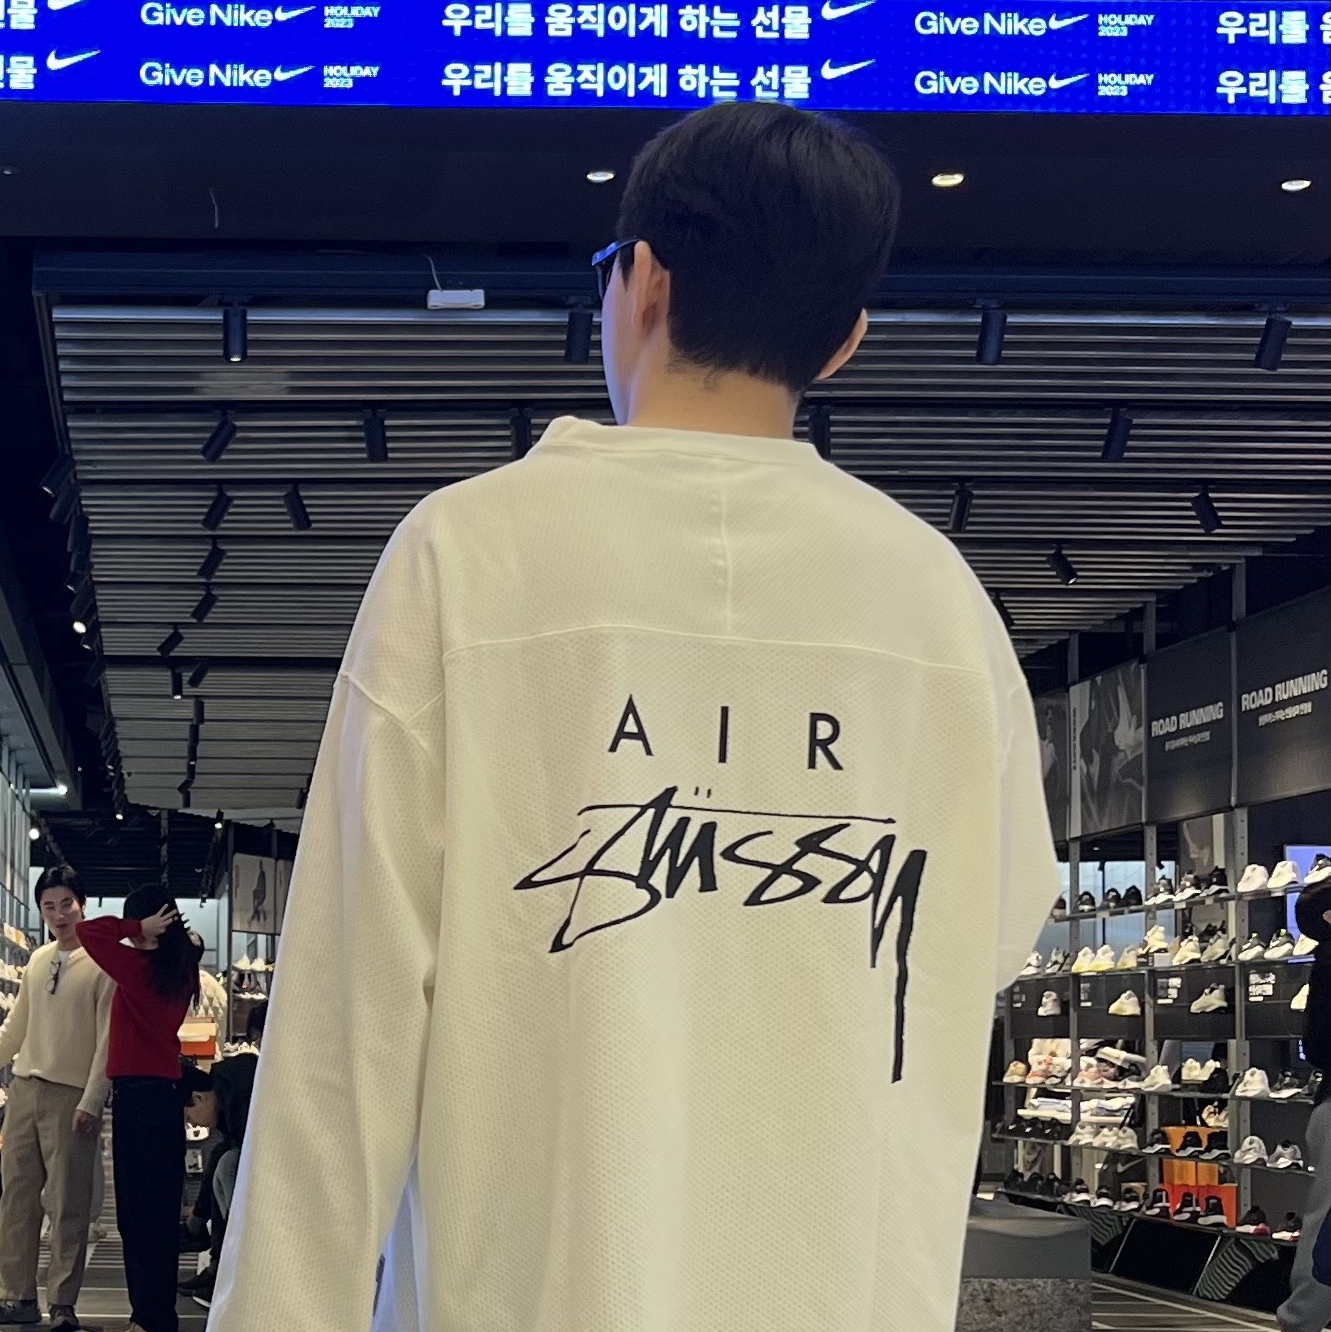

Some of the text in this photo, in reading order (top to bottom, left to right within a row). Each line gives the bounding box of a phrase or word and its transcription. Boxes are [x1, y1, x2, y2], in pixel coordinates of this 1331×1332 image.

[141, 2, 273, 28] Give Nike
[324, 6, 381, 18] HOLIDAY
[442, 3, 812, 39] 우리를 움직이게 하는 선물
[915, 11, 1047, 36] Give Nike
[1098, 14, 1155, 26] HOLIDAY
[1098, 25, 1128, 37] 2023
[1216, 10, 1309, 44] 우리를
[140, 62, 272, 88] Give Nike
[324, 65, 380, 77] HOLIDAY
[442, 62, 811, 99] 우리를 움직이게 하는 선물
[915, 71, 1047, 96] Give Nike
[1098, 73, 1154, 86] HOLIDAY
[1098, 85, 1128, 96] 2023
[1216, 70, 1309, 104] 우리를
[1242, 669, 1328, 711] ROAD RUNNING
[608, 694, 843, 770] AIR
[1152, 702, 1224, 737] ROAD RUNNING
